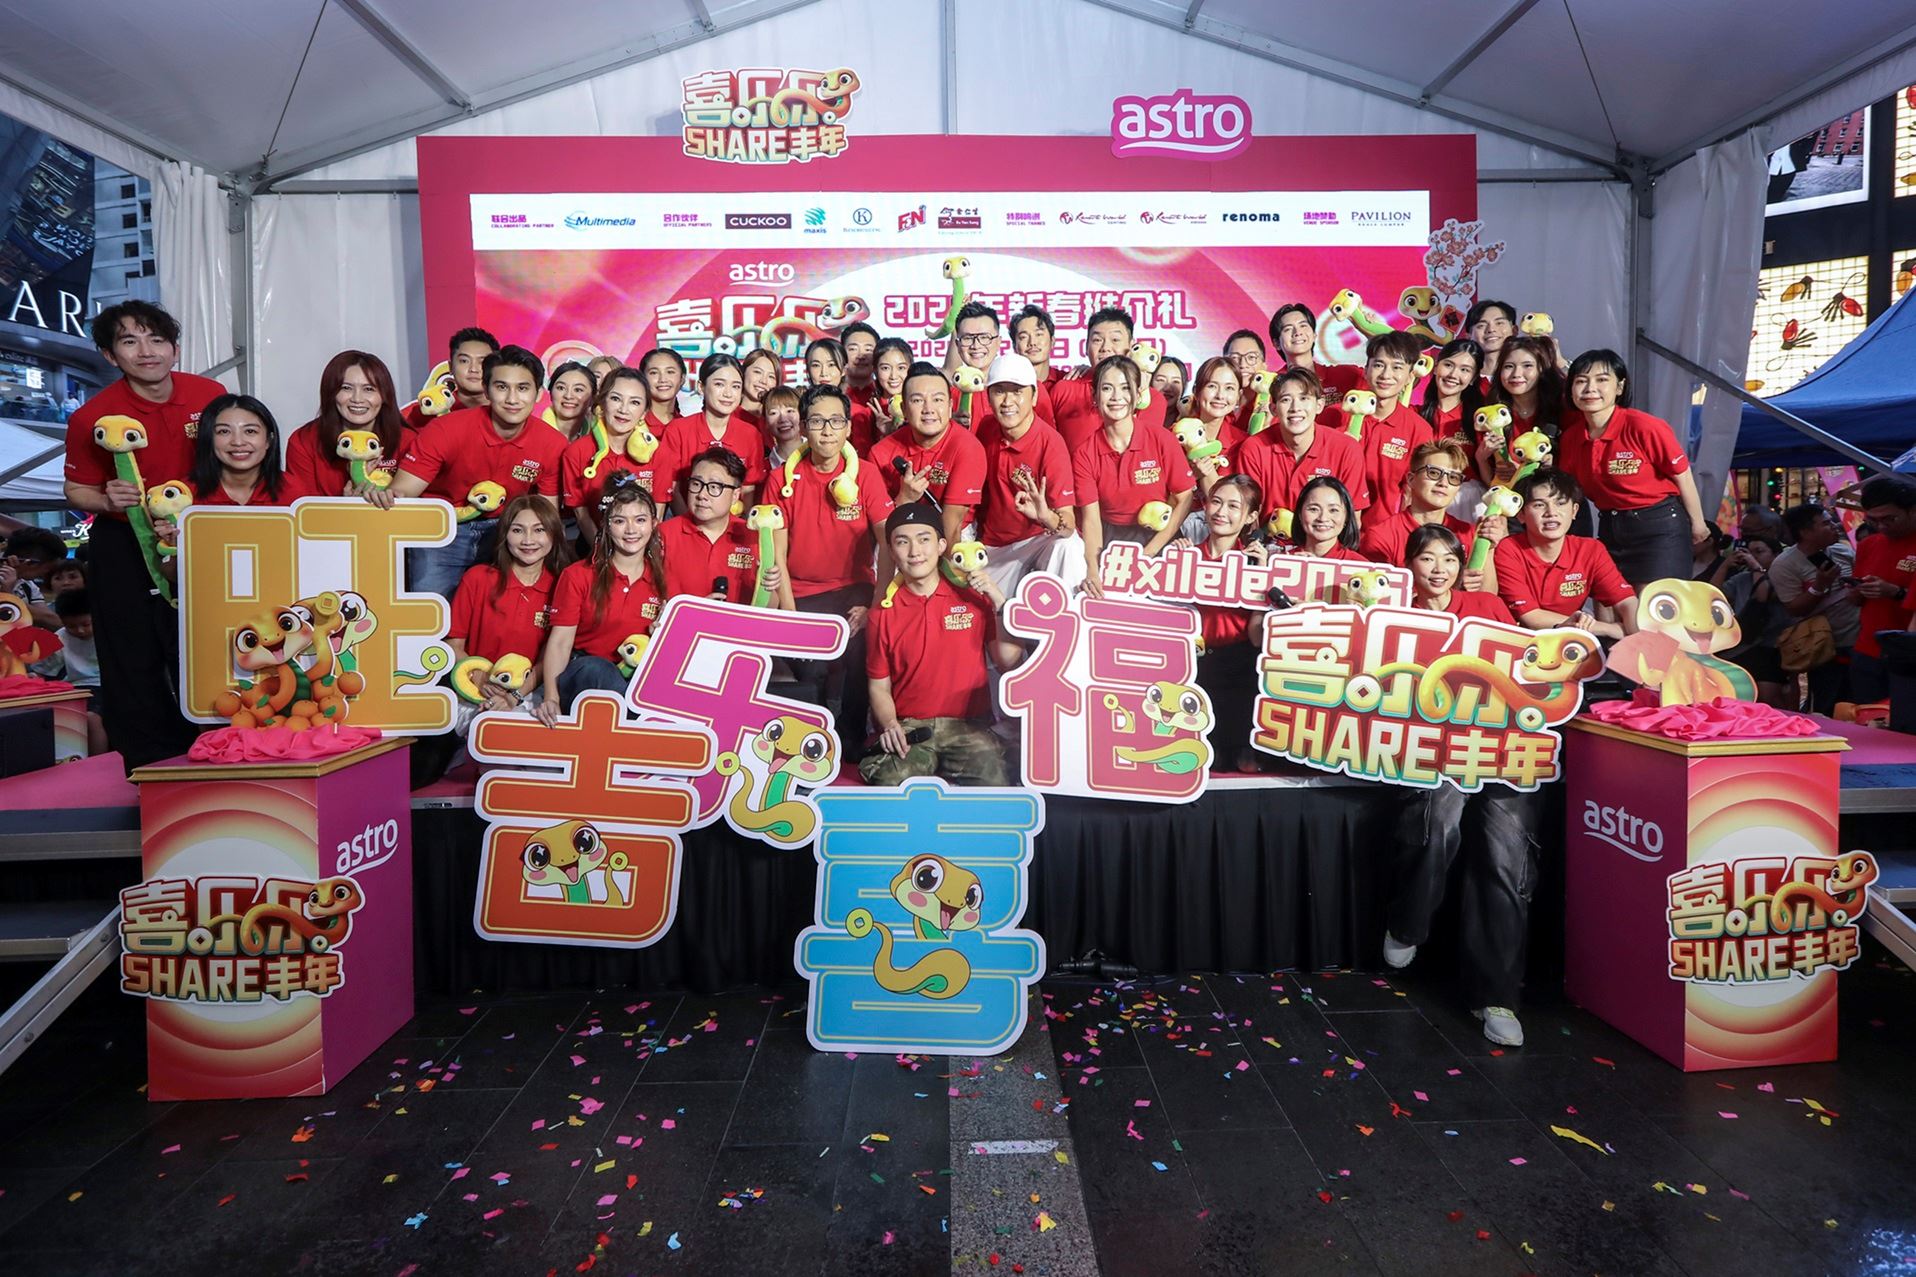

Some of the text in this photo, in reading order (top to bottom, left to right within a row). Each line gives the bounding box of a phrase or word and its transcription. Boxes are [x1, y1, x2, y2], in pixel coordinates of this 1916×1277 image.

[685, 124, 846, 162] SHARE 丰年
[1119, 97, 1245, 140] astro
[575, 216, 636, 226] Multimedia
[729, 216, 787, 226] CUCKOO
[1222, 212, 1280, 222] renoma
[1351, 211, 1411, 220] PAVILION
[729, 261, 795, 282] astro
[8, 279, 102, 338] AR
[1007, 576, 1205, 796] 福
[1254, 699, 1558, 789] SHARE 丰年
[475, 695, 714, 943] 吉
[1584, 800, 1664, 856] astro
[336, 819, 398, 875] astro
[802, 783, 1039, 1045] 喜
[122, 954, 341, 1002] SHARE 丰年
[1671, 926, 1857, 982] SHARE 丰年
